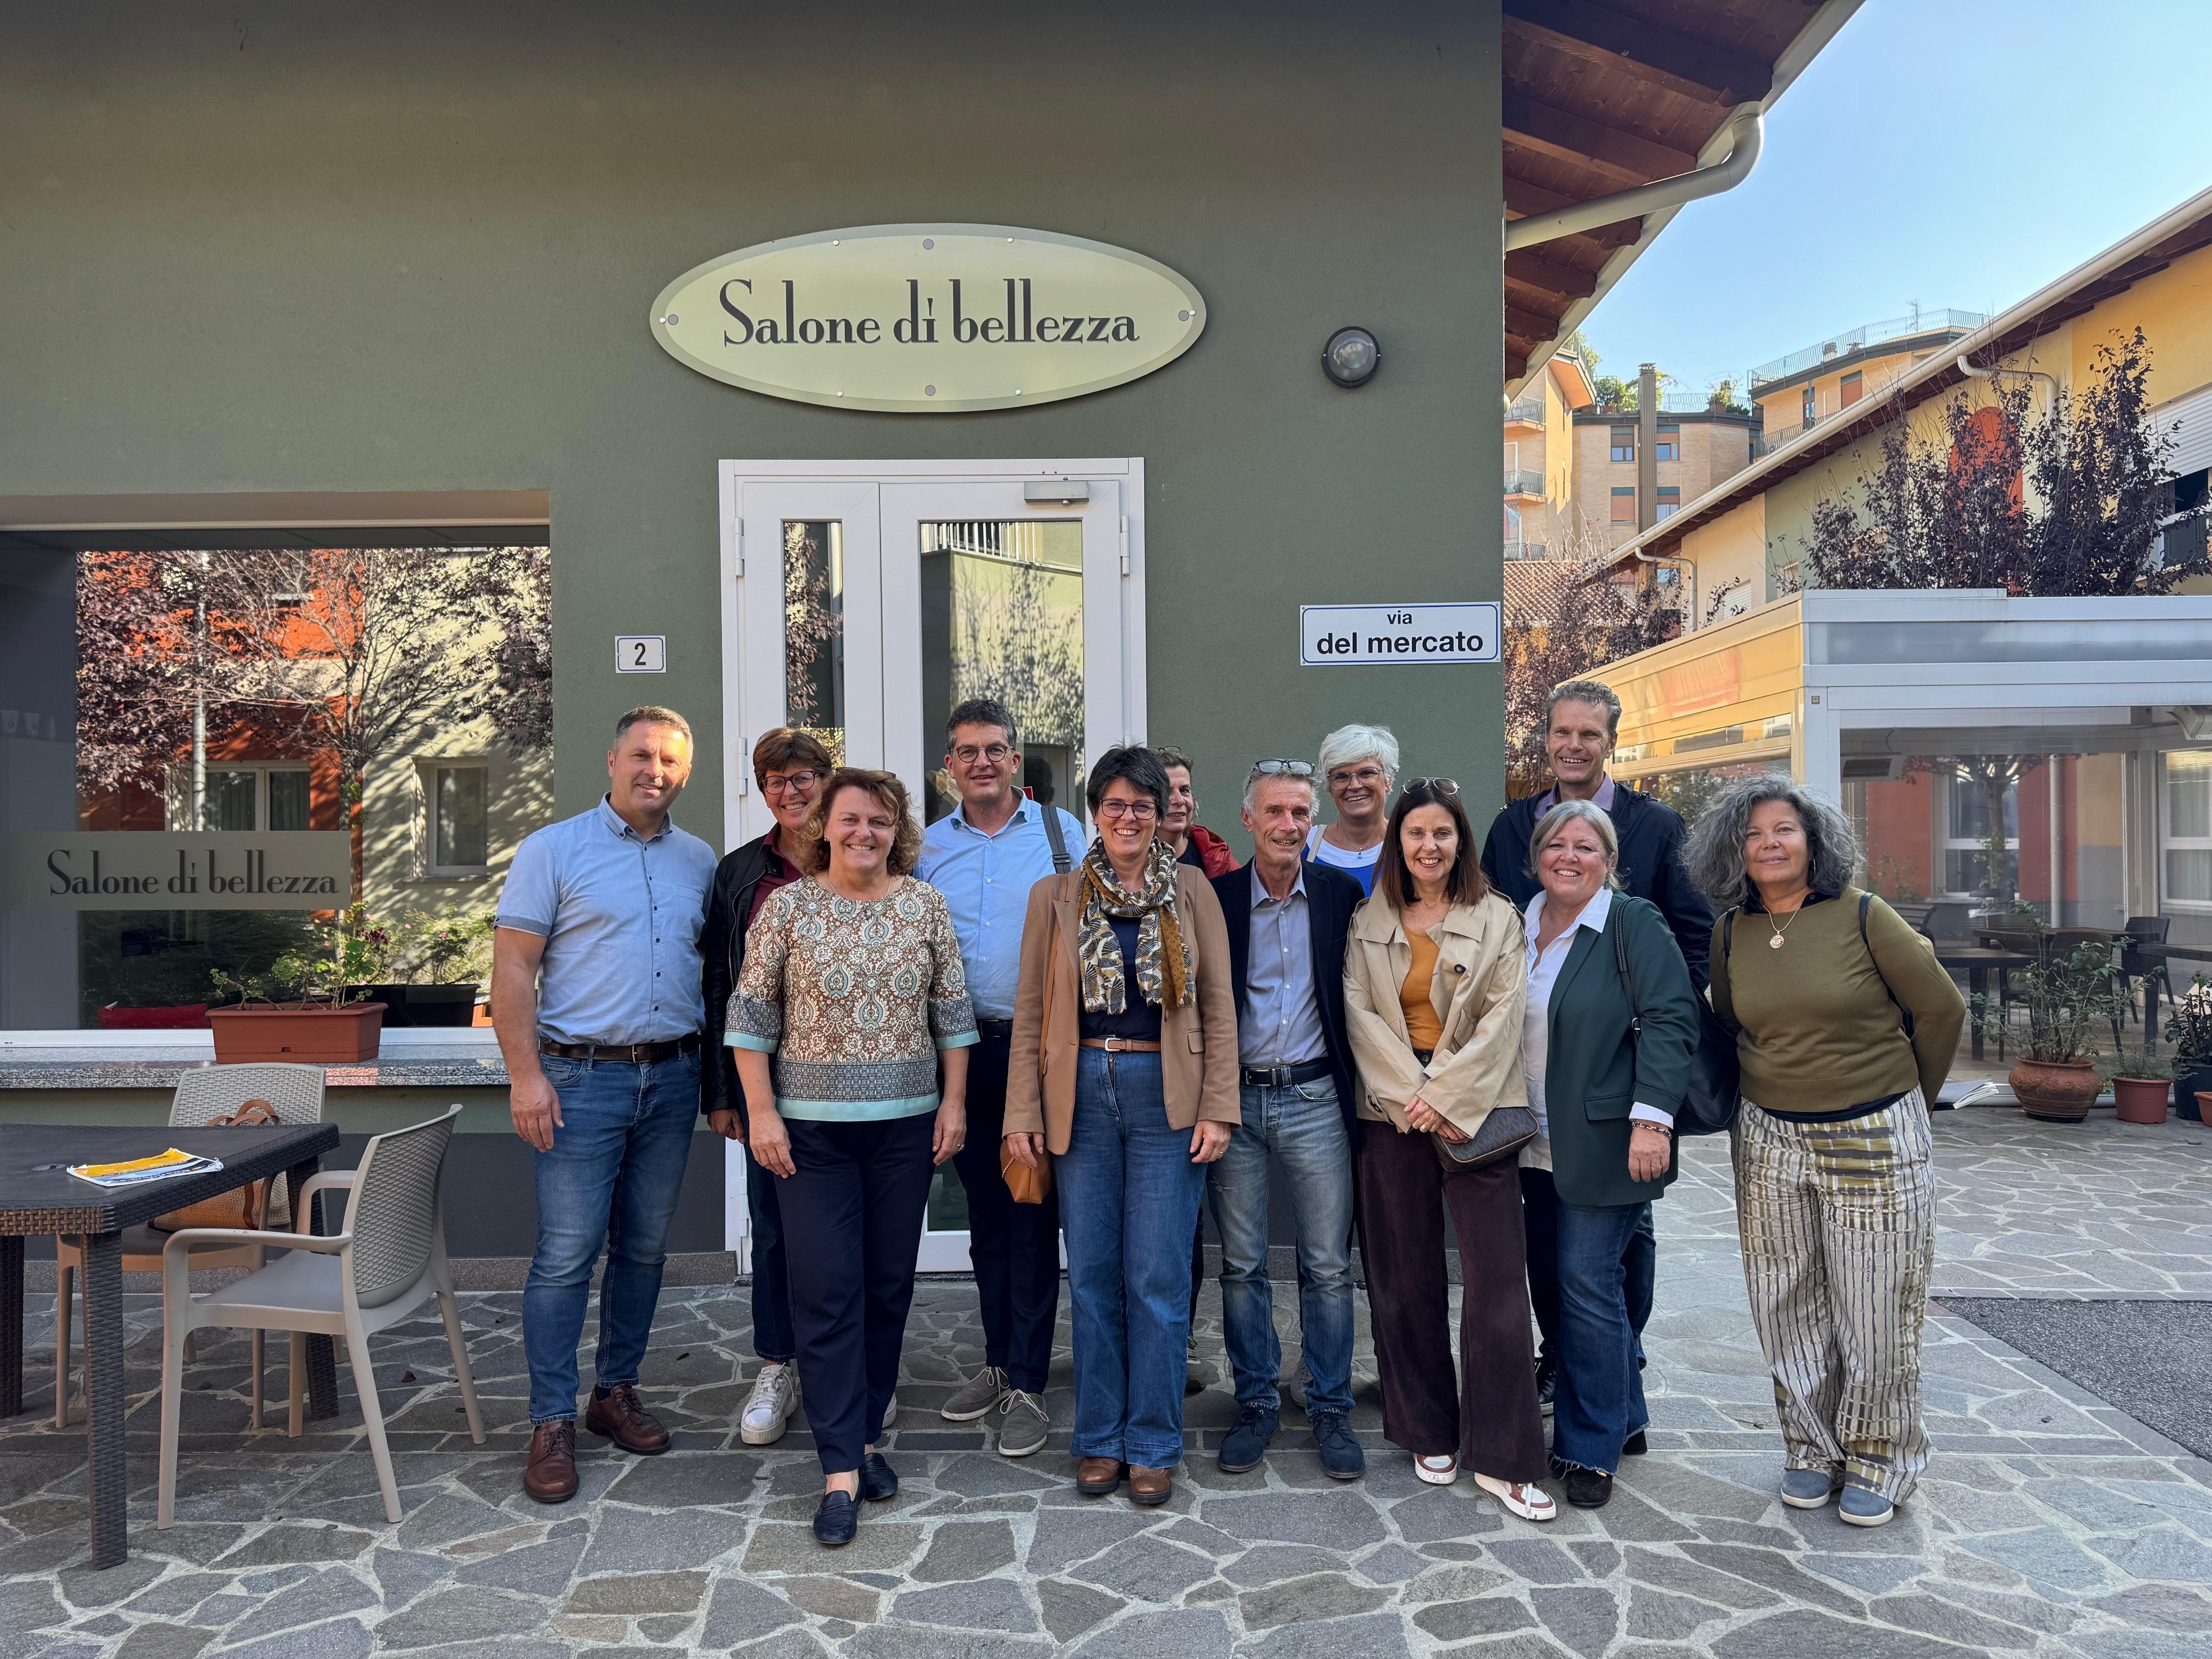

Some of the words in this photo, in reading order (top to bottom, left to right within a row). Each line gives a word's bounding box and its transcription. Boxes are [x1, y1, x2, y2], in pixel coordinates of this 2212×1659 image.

[719, 279, 881, 347] Salone
[893, 279, 939, 344] di
[948, 278, 1140, 343] bellezza
[1387, 610, 1412, 625] via
[634, 642, 646, 666] 2
[1317, 632, 1357, 655] del
[1368, 631, 1484, 654] mercato
[47, 849, 159, 896] Salone
[167, 849, 199, 894] di
[206, 849, 339, 895] bellezza
